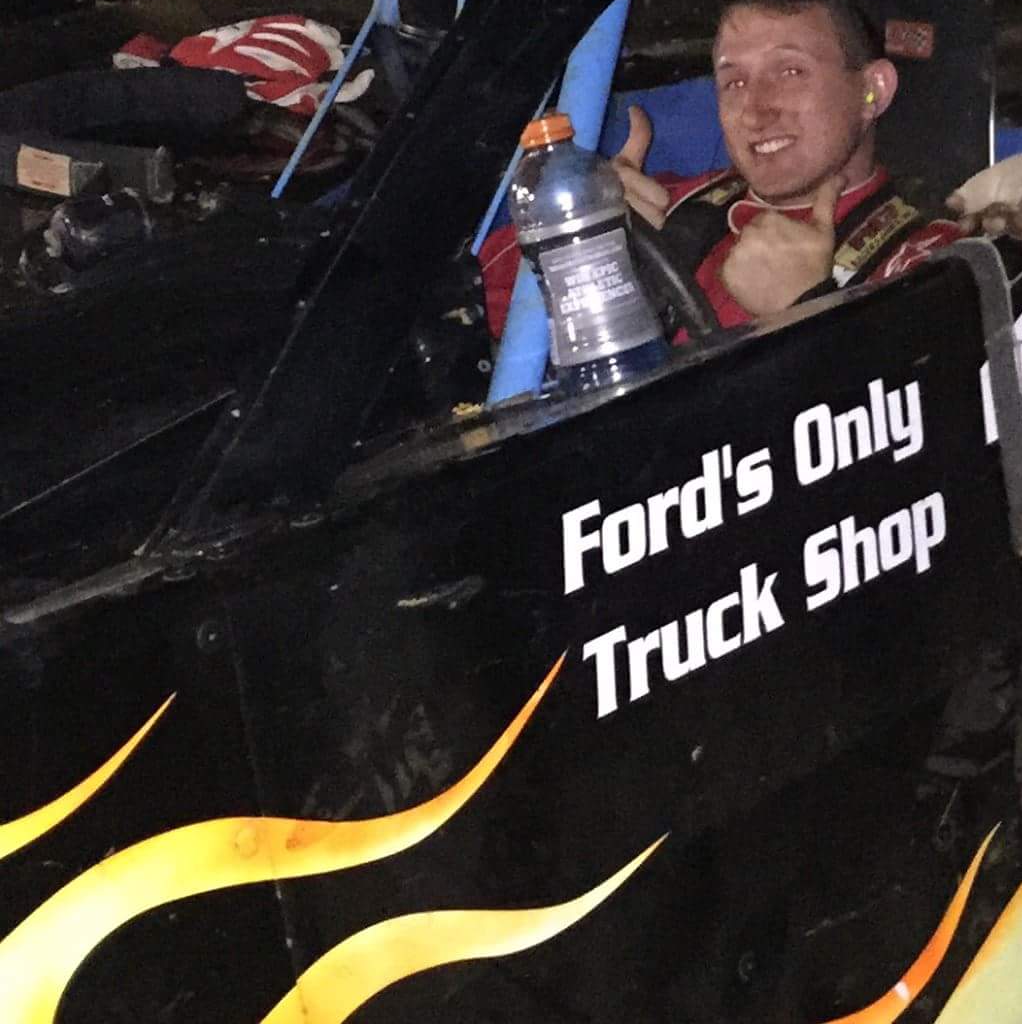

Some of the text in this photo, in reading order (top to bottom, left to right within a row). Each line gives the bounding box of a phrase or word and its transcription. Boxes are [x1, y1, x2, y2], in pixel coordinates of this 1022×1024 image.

[562, 379, 923, 595] Ford's Only
[582, 492, 946, 719] Truck Shop
